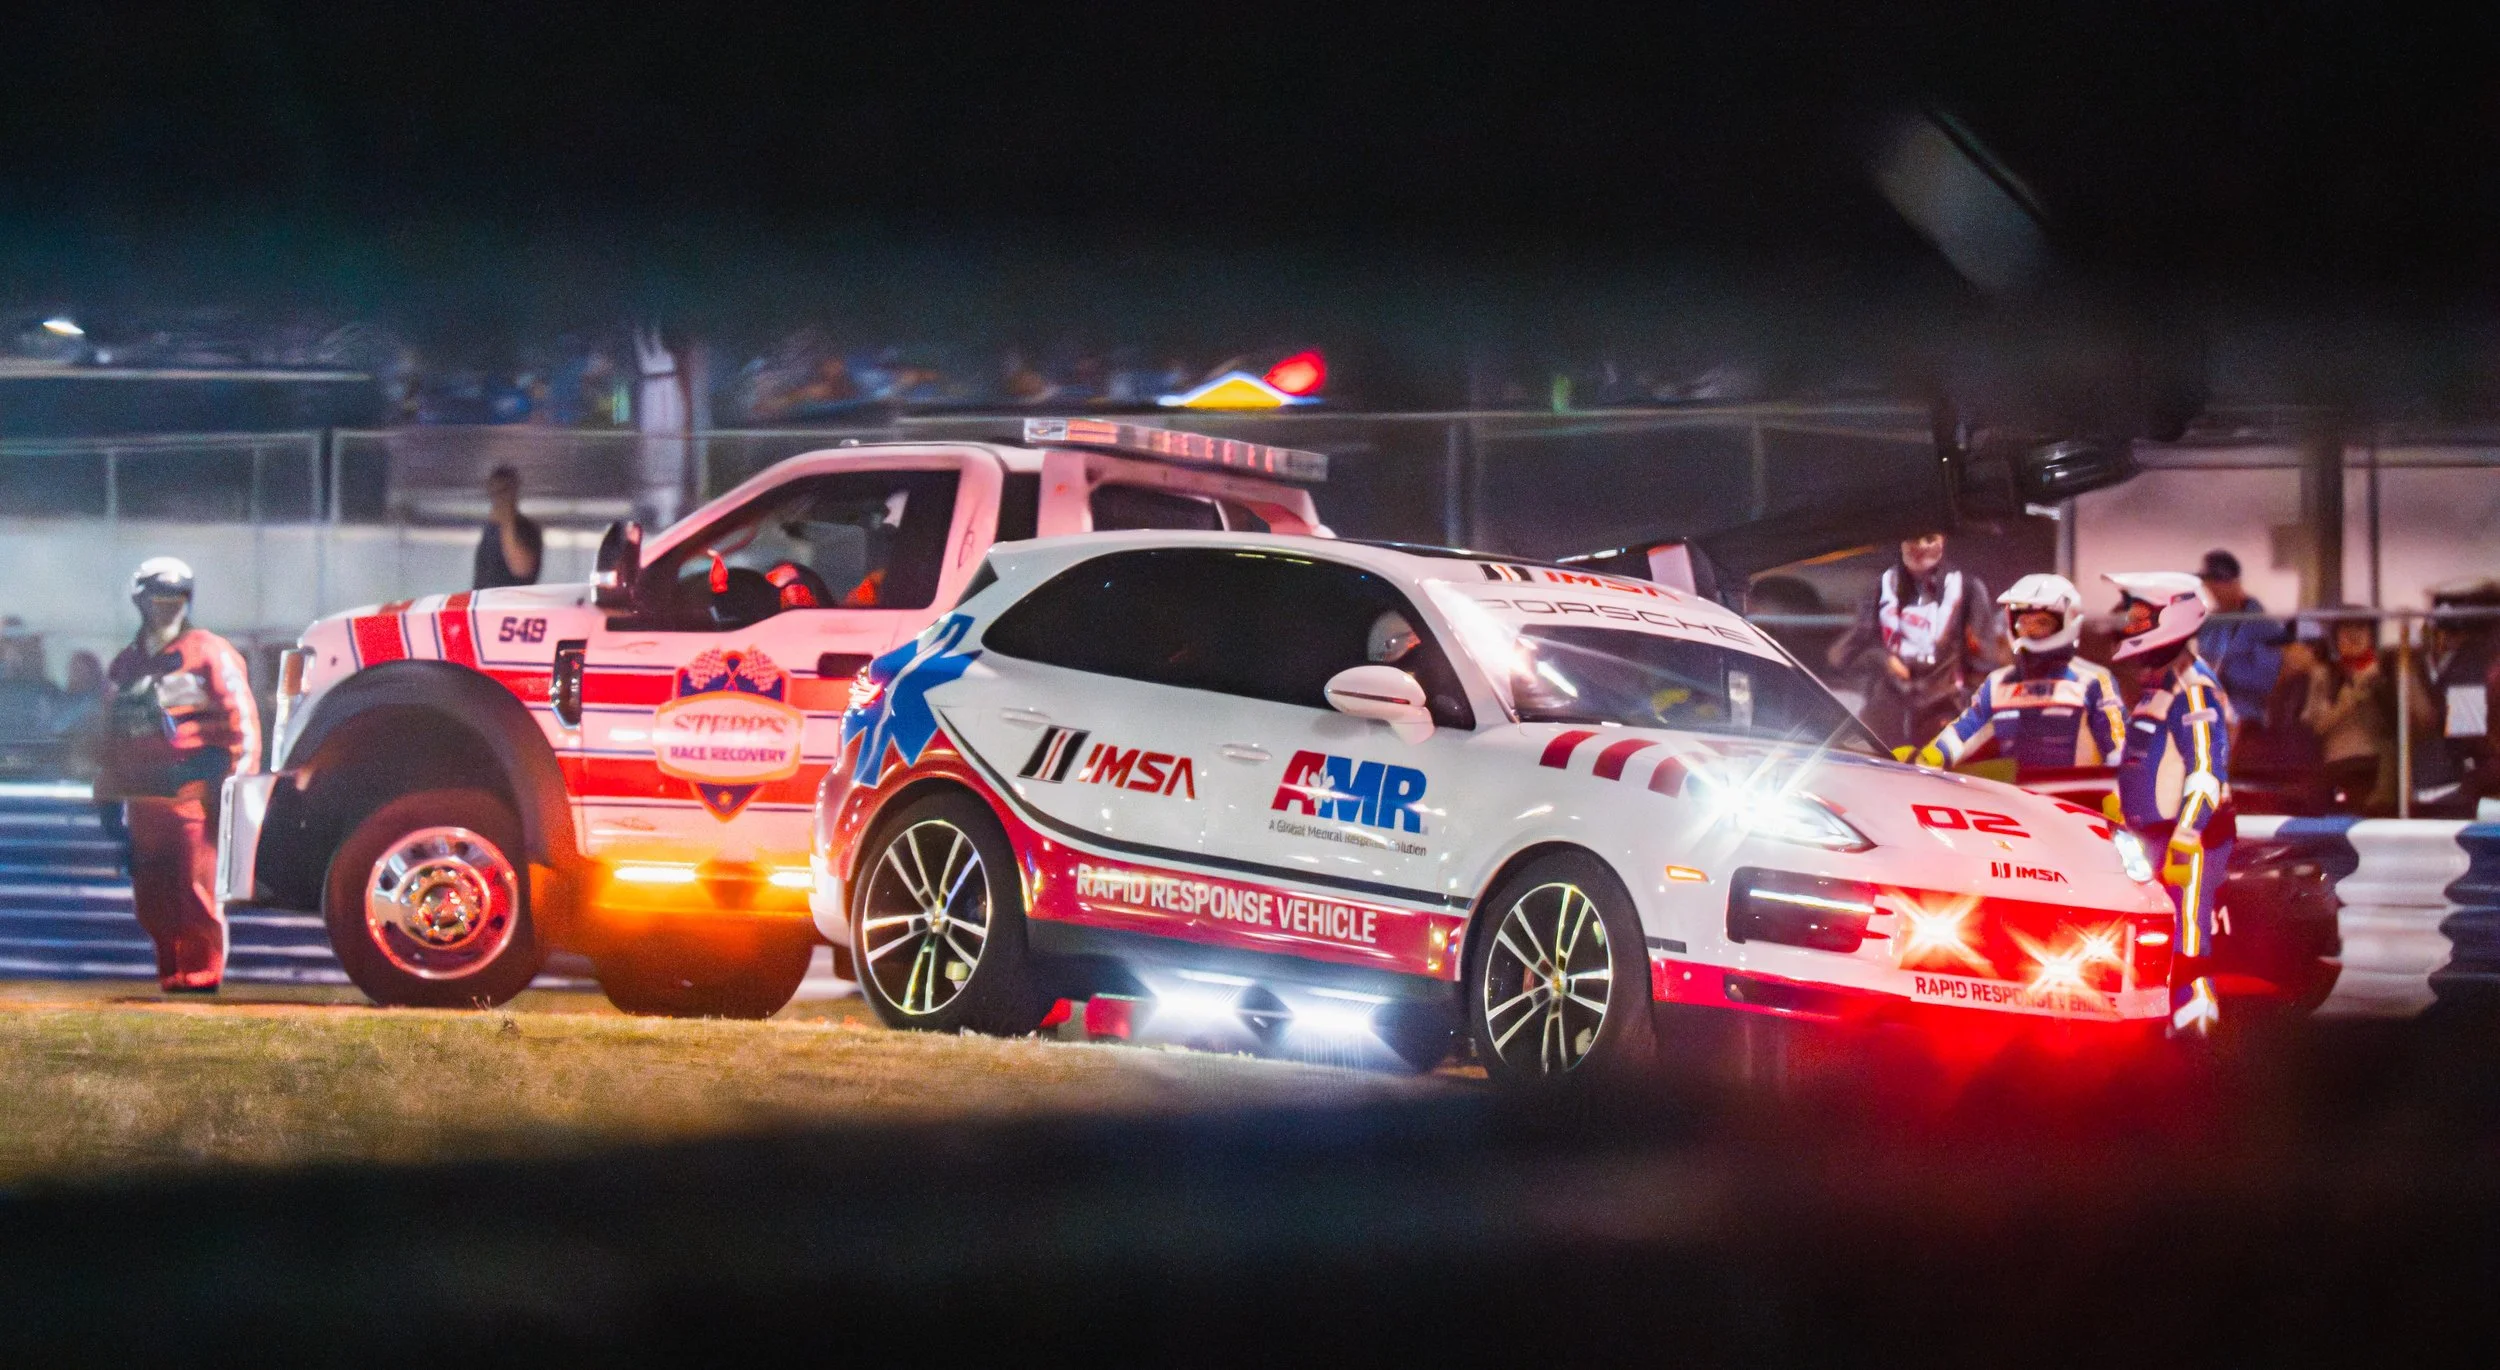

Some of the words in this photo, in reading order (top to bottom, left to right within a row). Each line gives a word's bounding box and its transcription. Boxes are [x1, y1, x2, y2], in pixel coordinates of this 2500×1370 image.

[1474, 598, 1756, 647] PORSCHE
[670, 746, 707, 761] RACE
[711, 747, 786, 763] RECOVERY
[1077, 742, 1196, 801] IMSA
[1270, 750, 1427, 834] AMR
[1910, 804, 2031, 838] 02
[2015, 866, 2069, 884] IMSA
[1076, 862, 1147, 905] RAPID
[1150, 874, 1273, 927] RESPONSE
[1276, 896, 1377, 944] VEHICLE
[1914, 976, 1968, 998] RAPID
